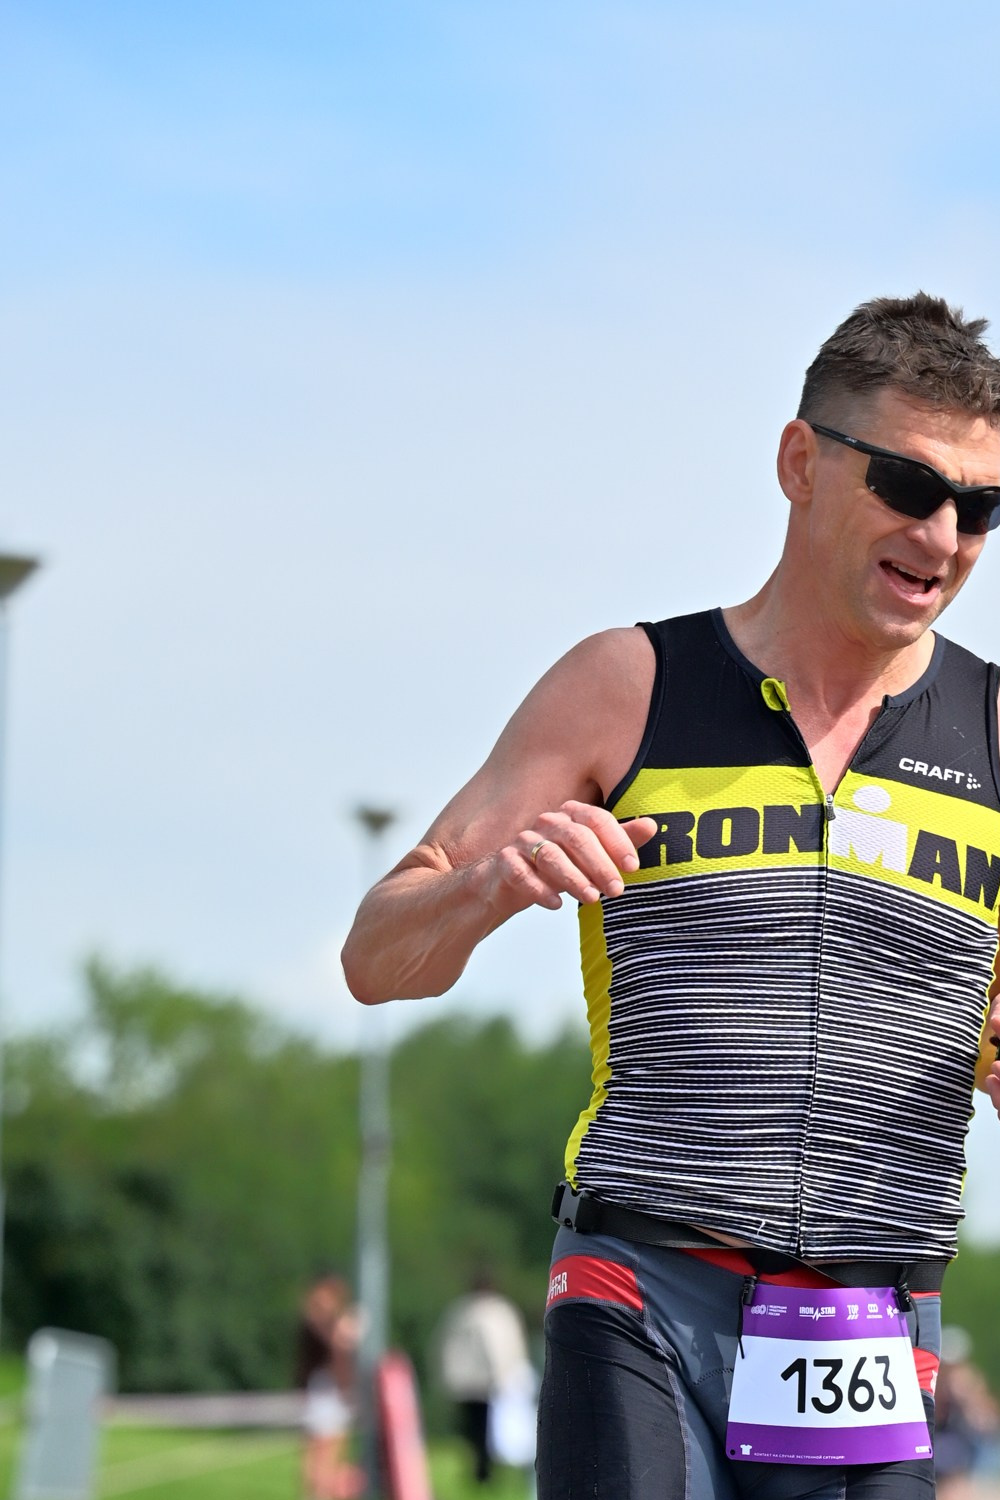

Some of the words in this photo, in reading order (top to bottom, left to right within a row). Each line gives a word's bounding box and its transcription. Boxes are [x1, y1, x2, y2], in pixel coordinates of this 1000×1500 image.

[899, 757, 965, 784] CRAFT
[799, 1306, 814, 1315] IRON
[820, 1306, 836, 1315] STAR
[780, 1355, 897, 1414] 1363
